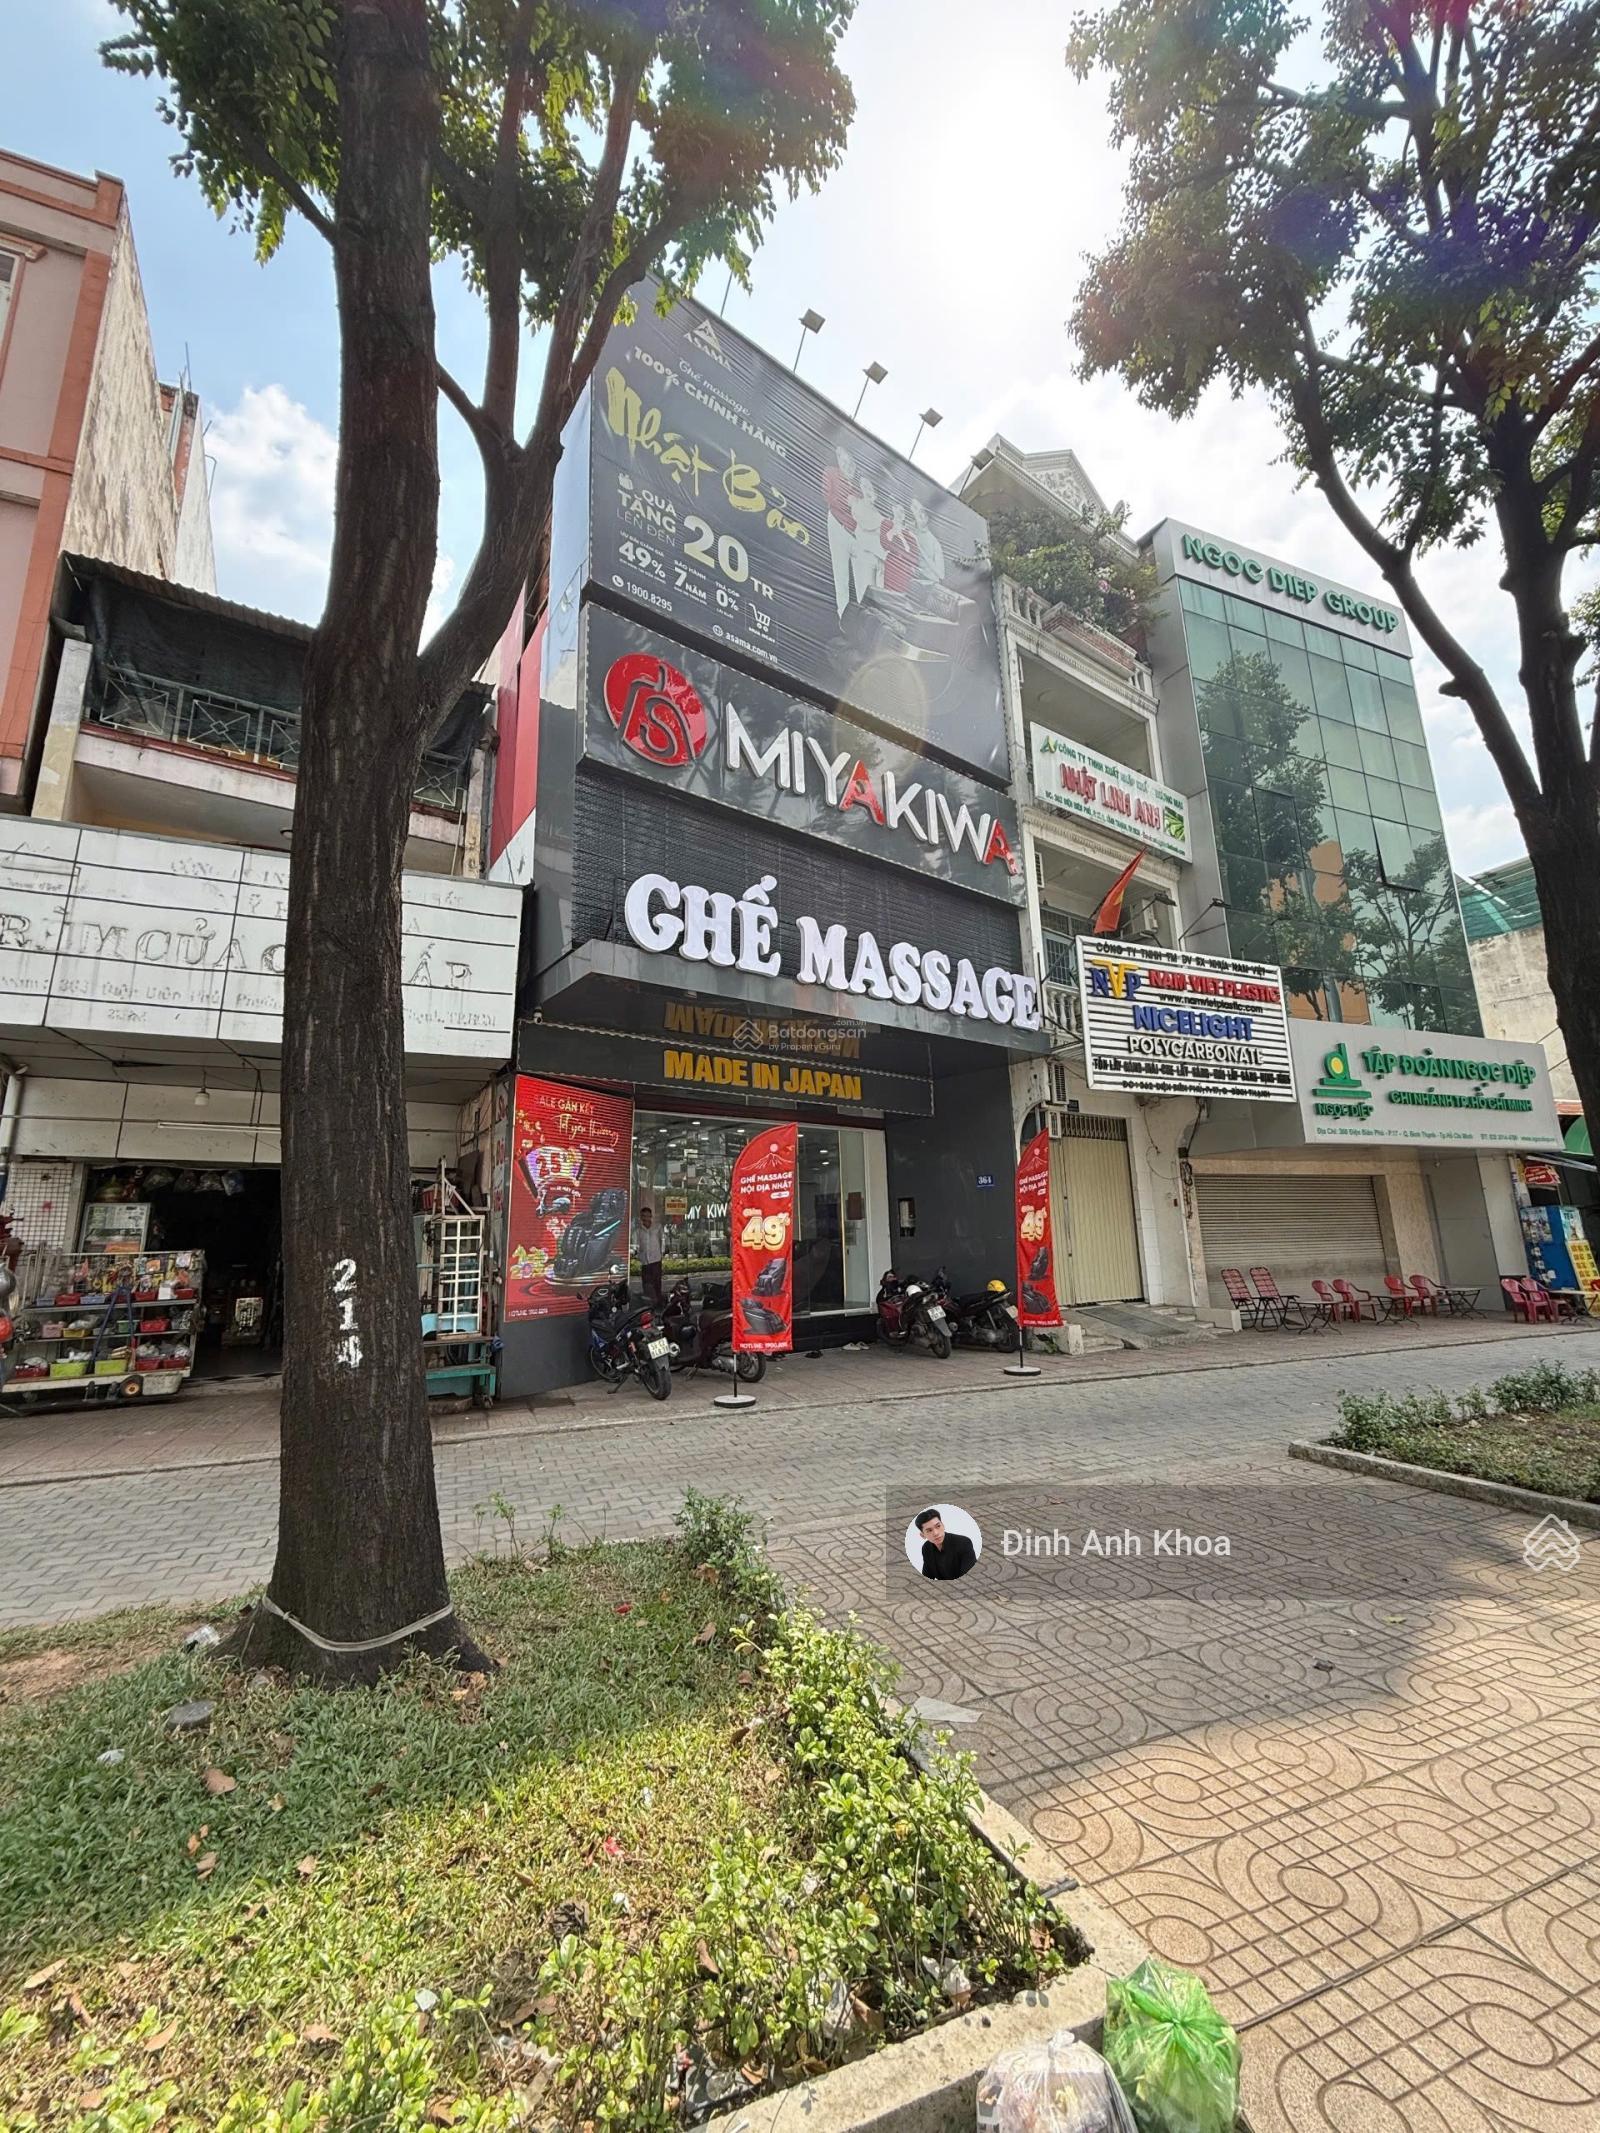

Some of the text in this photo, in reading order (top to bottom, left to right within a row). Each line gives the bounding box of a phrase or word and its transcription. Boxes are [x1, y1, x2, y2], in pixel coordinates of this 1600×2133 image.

[683, 332, 733, 373] ASAMA
[634, 346, 680, 386] 100%
[684, 383, 739, 425] CHÍNH
[703, 381, 751, 416] massage
[619, 540, 666, 578] 49%
[684, 515, 748, 583] 20
[626, 581, 673, 613] 1900.8295
[674, 566, 688, 587] 7
[685, 582, 707, 600] NĂM
[716, 589, 740, 611] 0%
[750, 577, 775, 601] TR
[1182, 533, 1399, 633] NGOC DIEP GROUP
[725, 632, 779, 664] asama.com.vn
[1077, 752, 1086, 763] TY
[725, 701, 1019, 876] MIYAKIWA
[1060, 763, 1161, 830] NHẬT LINH ANH
[625, 873, 1039, 1031] GHẾ MASSAGE
[1096, 941, 1123, 955] CÔNG
[1127, 946, 1136, 957] TY
[1088, 958, 1142, 1000] NVP
[1147, 969, 1281, 1003] NAM VIET PLASTIC
[1159, 993, 1264, 1014] www.namvietplastic.com
[1132, 1005, 1254, 1041] NICELIGHT
[1127, 1035, 1264, 1065] POLYCARBONATE
[664, 1050, 862, 1101] MADE IN JAPAN
[1361, 1045, 1537, 1090] TẬP ĐOÀN NGỌC DIỆP
[1314, 1102, 1374, 1122] NGỌC DIỆP
[1389, 1090, 1412, 1105] CHI
[1412, 1086, 1453, 1108] NHÁNH
[1508, 1097, 1534, 1112] MINH
[740, 1171, 793, 1185] GHẾ MASSAGE
[740, 1180, 793, 1195] NỘI ĐỊA NHẬT
[978, 1176, 992, 1184] 364
